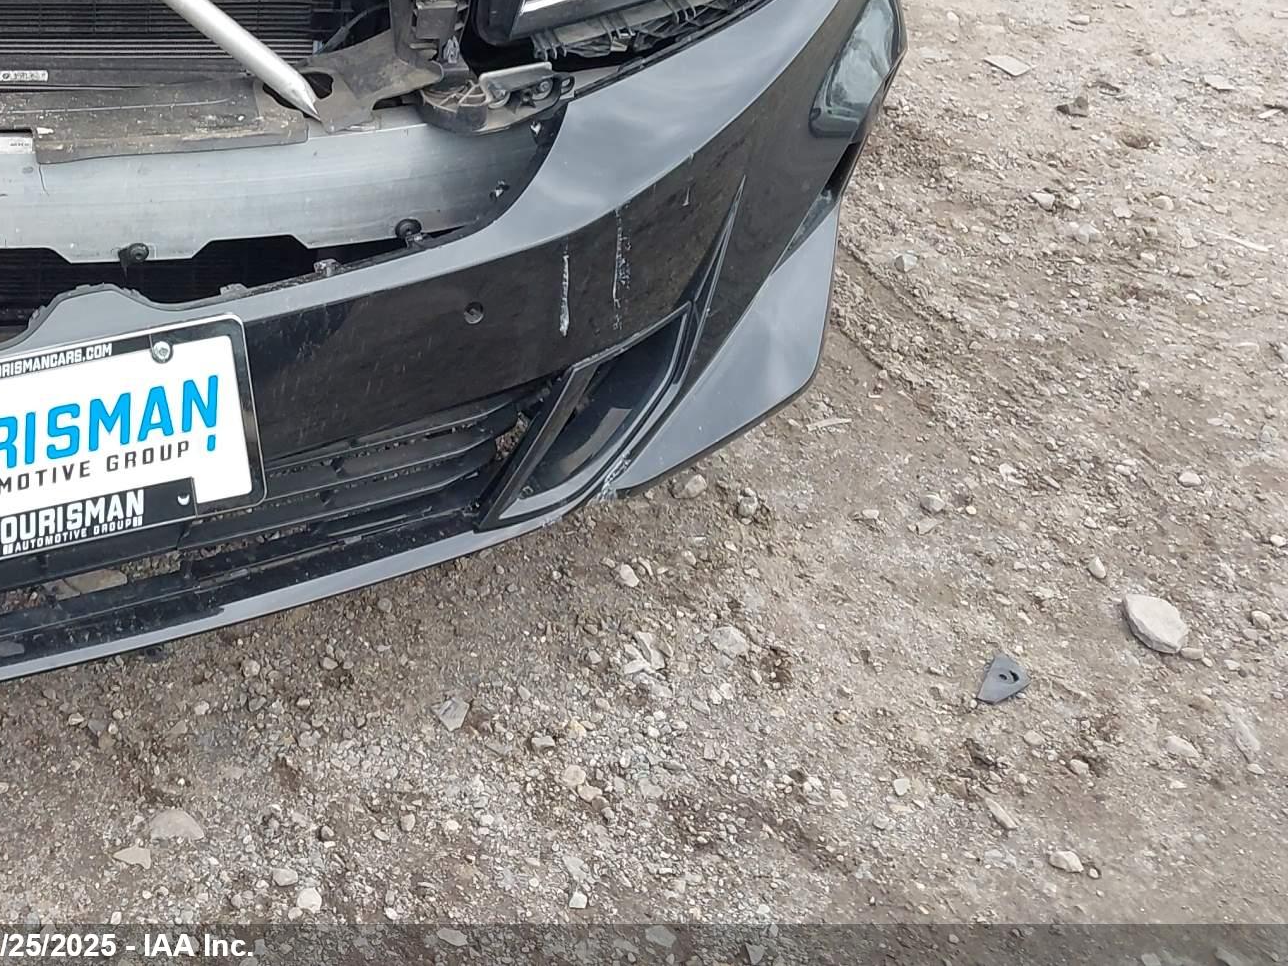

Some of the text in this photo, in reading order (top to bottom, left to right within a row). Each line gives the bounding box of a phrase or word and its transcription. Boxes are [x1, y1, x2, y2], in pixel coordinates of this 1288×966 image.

[107, 440, 190, 473] GROUP
[0, 489, 145, 545] OURISMAN
[14, 519, 133, 553] AUTOMOTIVE GROUP
